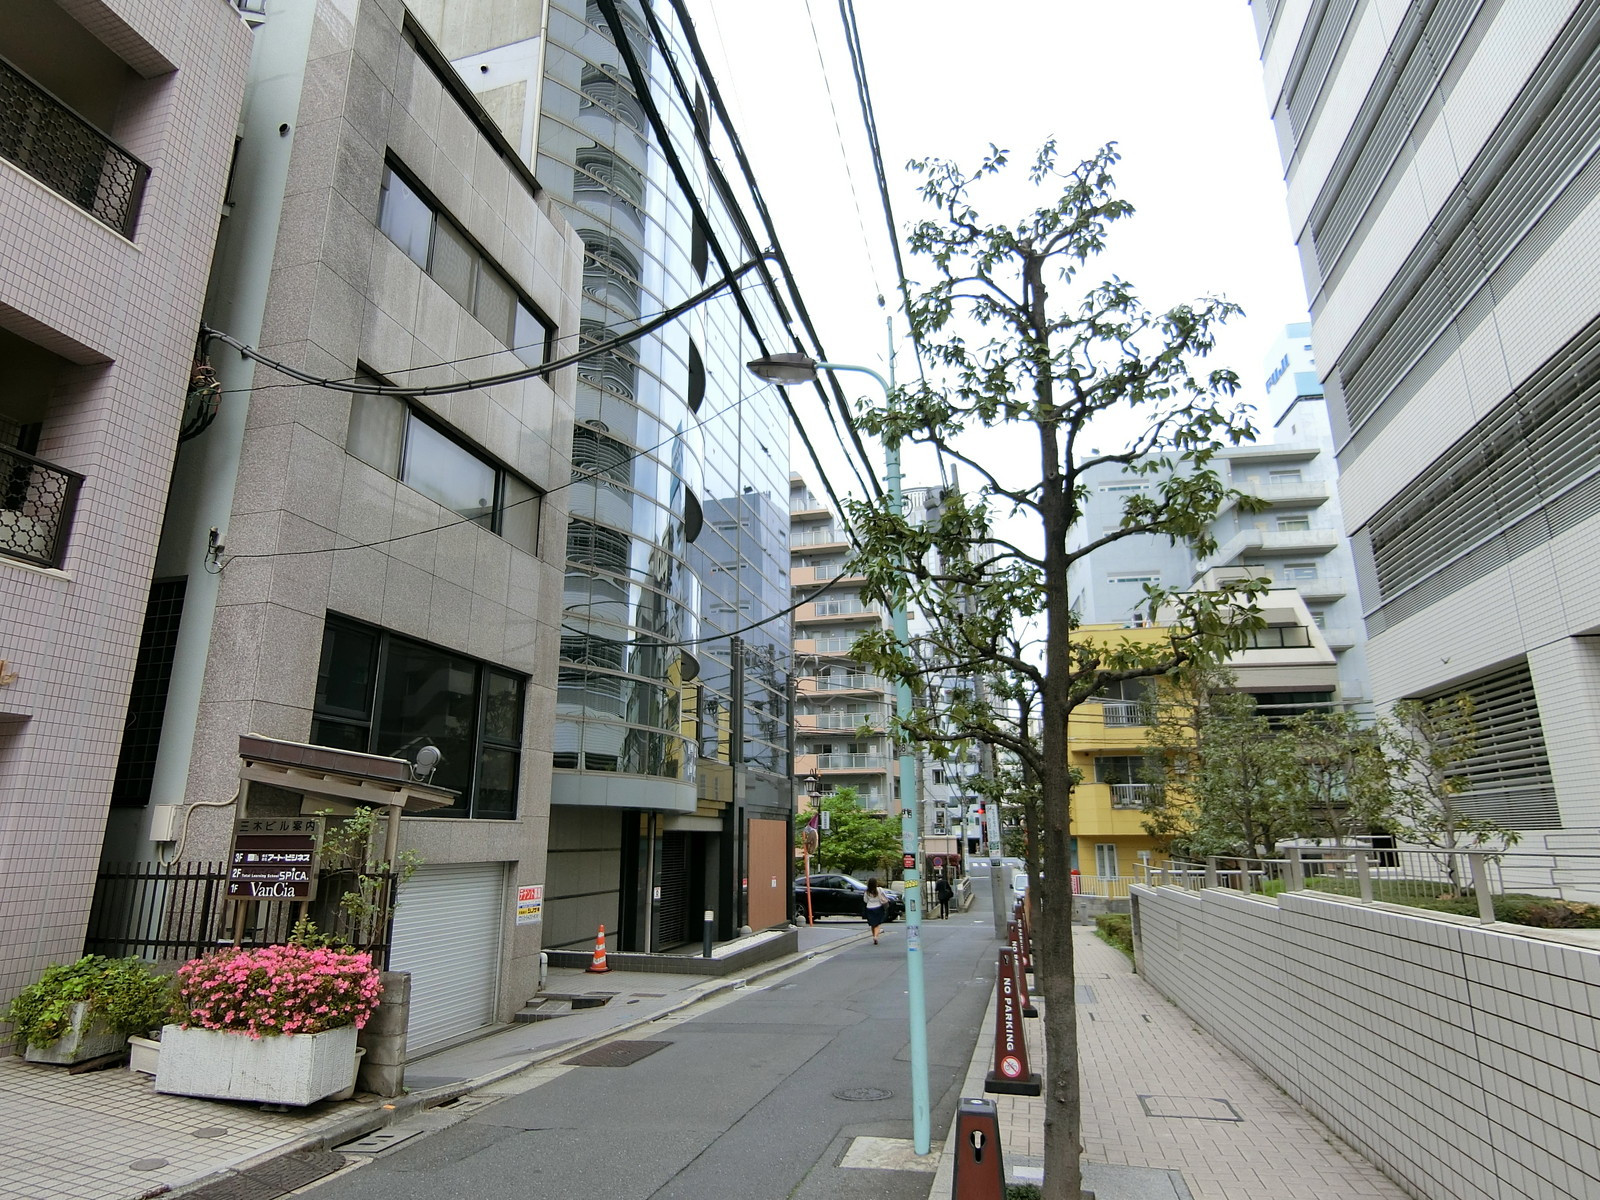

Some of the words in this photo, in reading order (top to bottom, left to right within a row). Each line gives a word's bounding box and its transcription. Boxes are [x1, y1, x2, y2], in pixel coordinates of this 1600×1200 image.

[239, 821, 315, 832] 三木ビル案内
[235, 853, 244, 863] 3F
[232, 868, 242, 878] 2F
[230, 884, 239, 893] 1F
[250, 881, 296, 897] VanCia
[1011, 940, 1018, 952] NO
[1003, 977, 1011, 994] NO
[1004, 997, 1014, 1051] PARKING
